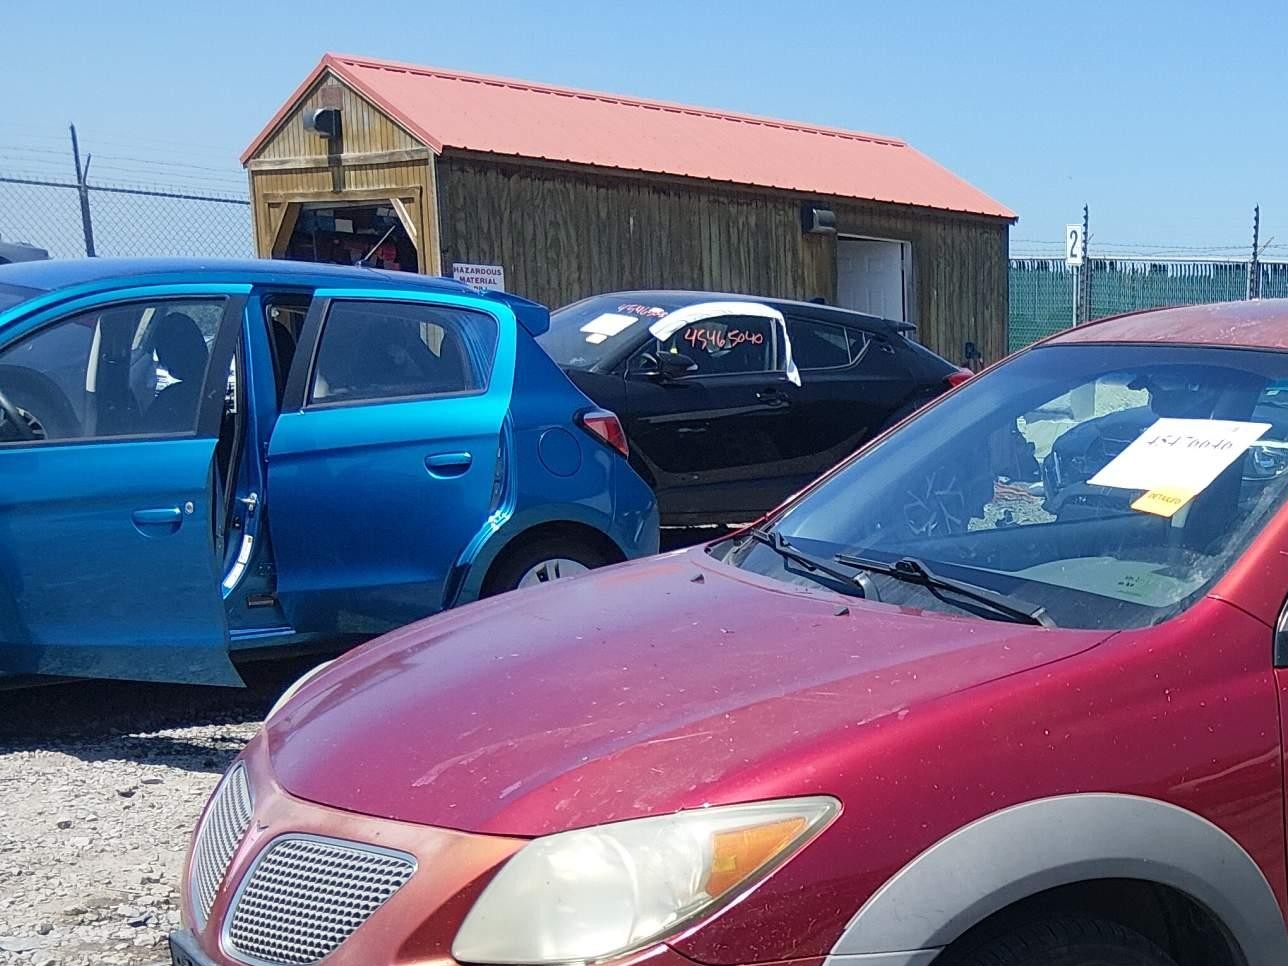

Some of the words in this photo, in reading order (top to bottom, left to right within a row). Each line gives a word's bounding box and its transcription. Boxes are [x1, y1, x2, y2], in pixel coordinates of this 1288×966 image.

[1070, 230, 1078, 258] 2
[453, 266, 502, 276] HAZARDOUS
[459, 276, 497, 285] MATERIAL
